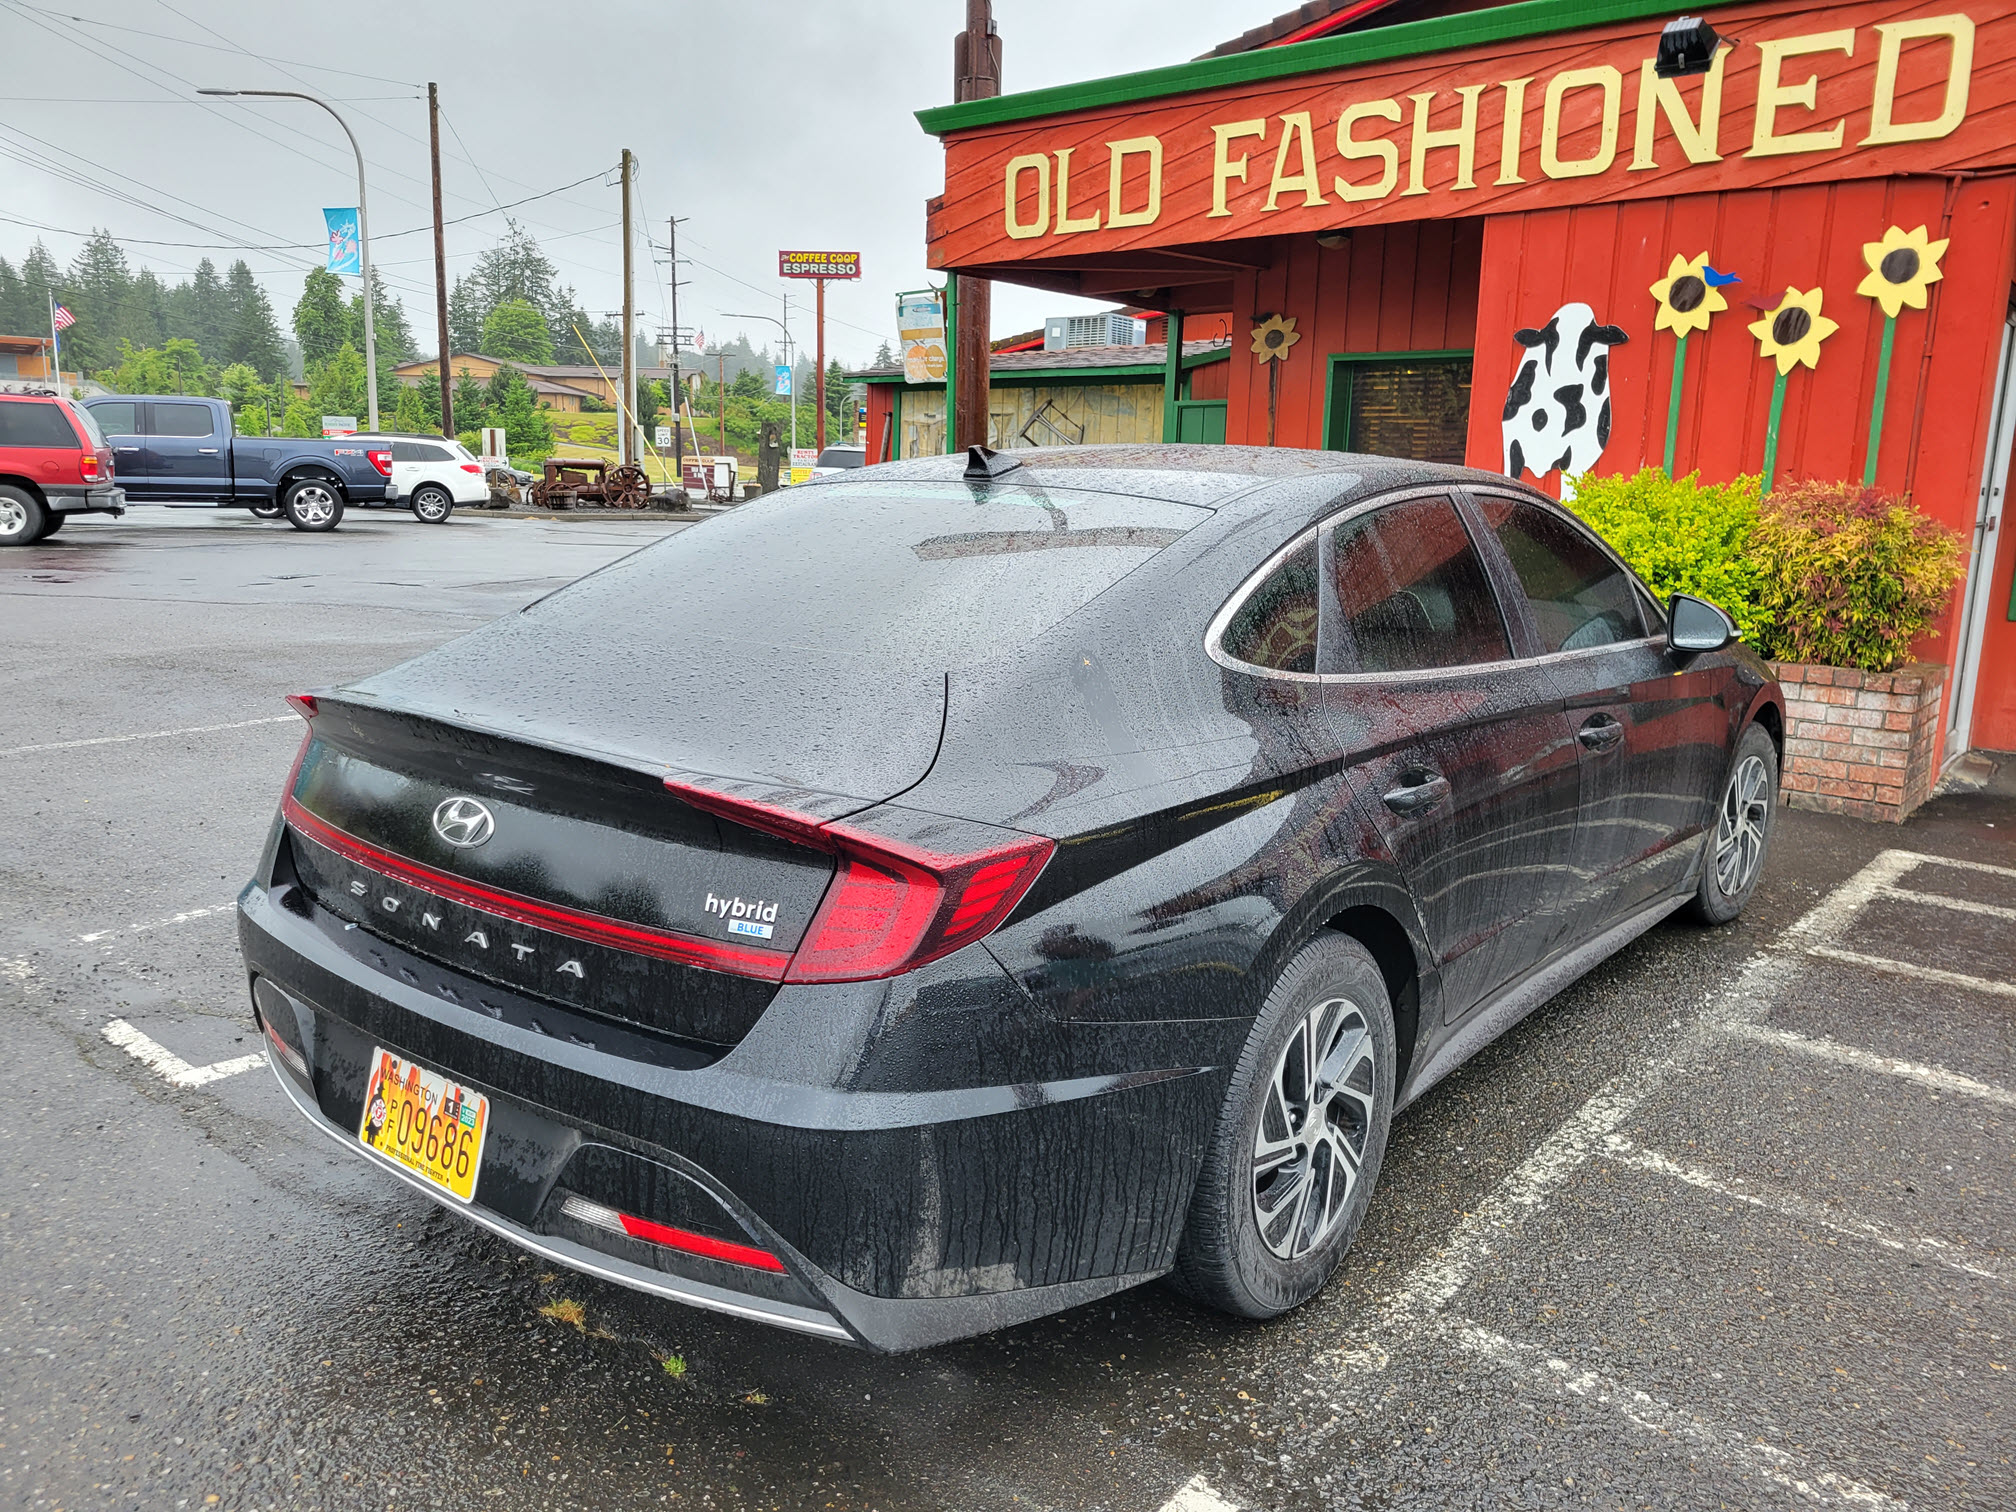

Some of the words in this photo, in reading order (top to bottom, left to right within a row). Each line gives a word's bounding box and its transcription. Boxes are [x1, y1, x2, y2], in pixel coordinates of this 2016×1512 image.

[1005, 134, 1164, 241] OLD
[1205, 12, 1976, 220] FASHIONED
[783, 263, 856, 274] ESPRESSO
[789, 253, 827, 263] COFFEE
[829, 254, 857, 263] COOP
[657, 437, 670, 445] 30
[705, 893, 778, 923] hybrid
[350, 880, 585, 978] SONATA
[737, 923, 764, 935] BLUE
[380, 1067, 438, 1105] WASHINGTON
[397, 1100, 473, 1178] 09686
[385, 1144, 415, 1165] PROFESSIONAL
